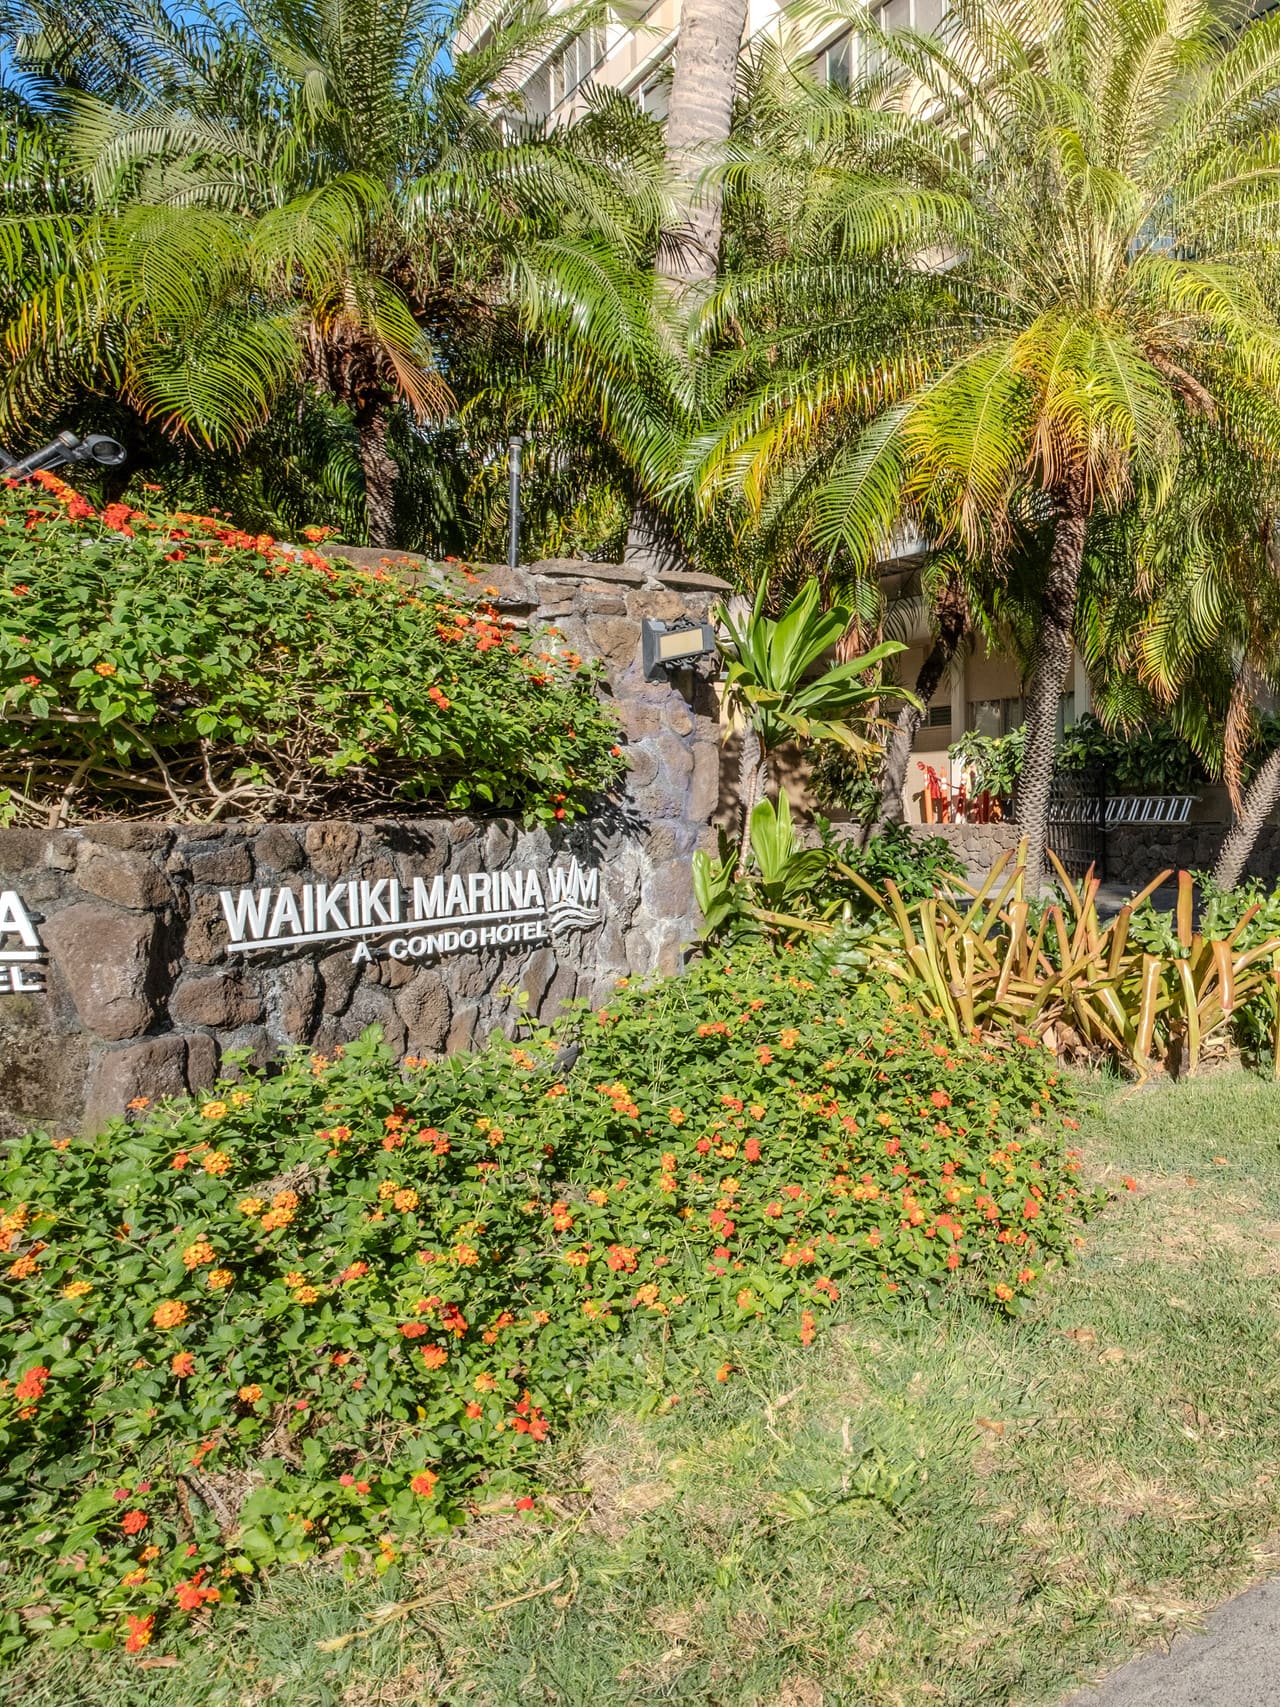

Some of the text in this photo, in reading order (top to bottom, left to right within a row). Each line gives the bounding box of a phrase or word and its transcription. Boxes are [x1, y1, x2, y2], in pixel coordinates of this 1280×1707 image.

[220, 869, 545, 942] WAIKIKI MARINA
[351, 920, 549, 964] A CONDO HOTEL
